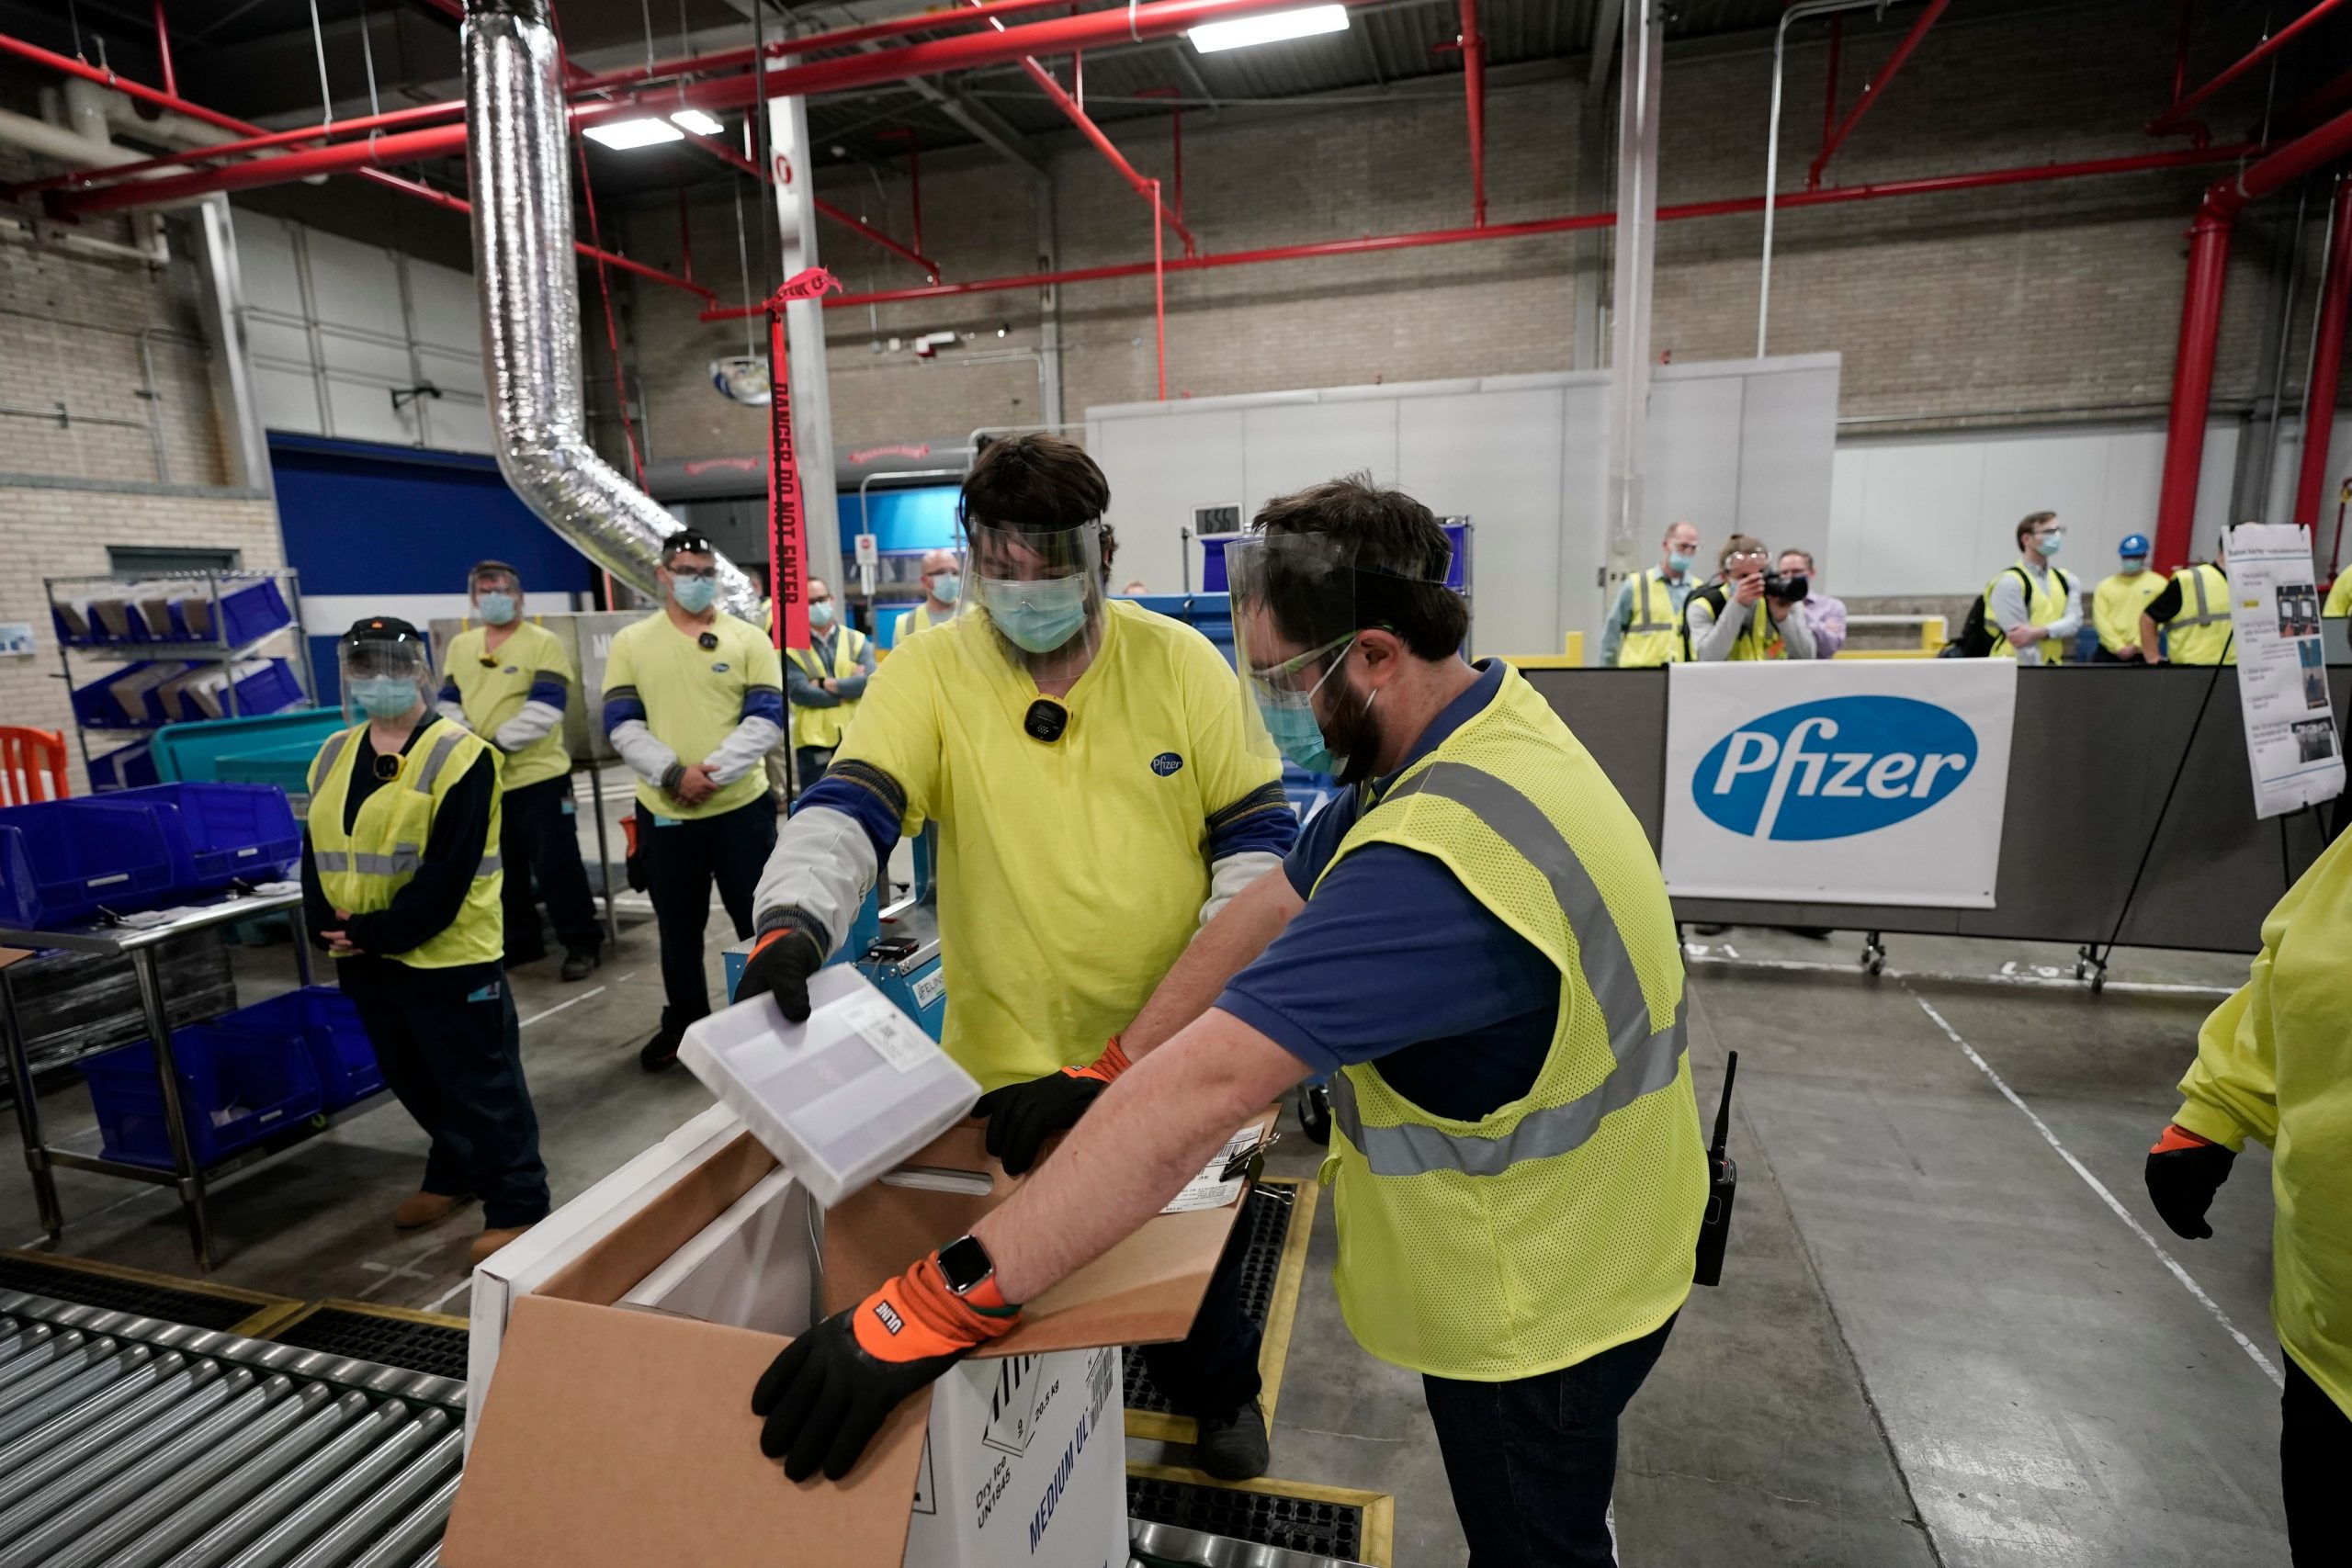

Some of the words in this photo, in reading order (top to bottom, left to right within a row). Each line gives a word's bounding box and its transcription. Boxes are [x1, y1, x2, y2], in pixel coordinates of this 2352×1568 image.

[775, 502, 796, 538] NOT
[776, 545, 798, 604] ENTER
[1153, 755, 1182, 776] Pfizer
[1713, 716, 1967, 840] Pfizer
[876, 1302, 902, 1333] ULINE
[1035, 1392, 1049, 1423] 20.5
[977, 1477, 991, 1509] Dry
[993, 1456, 1006, 1481] Ice
[978, 1467, 1010, 1529] UN1845
[1029, 1440, 1074, 1555] MEDIUM
